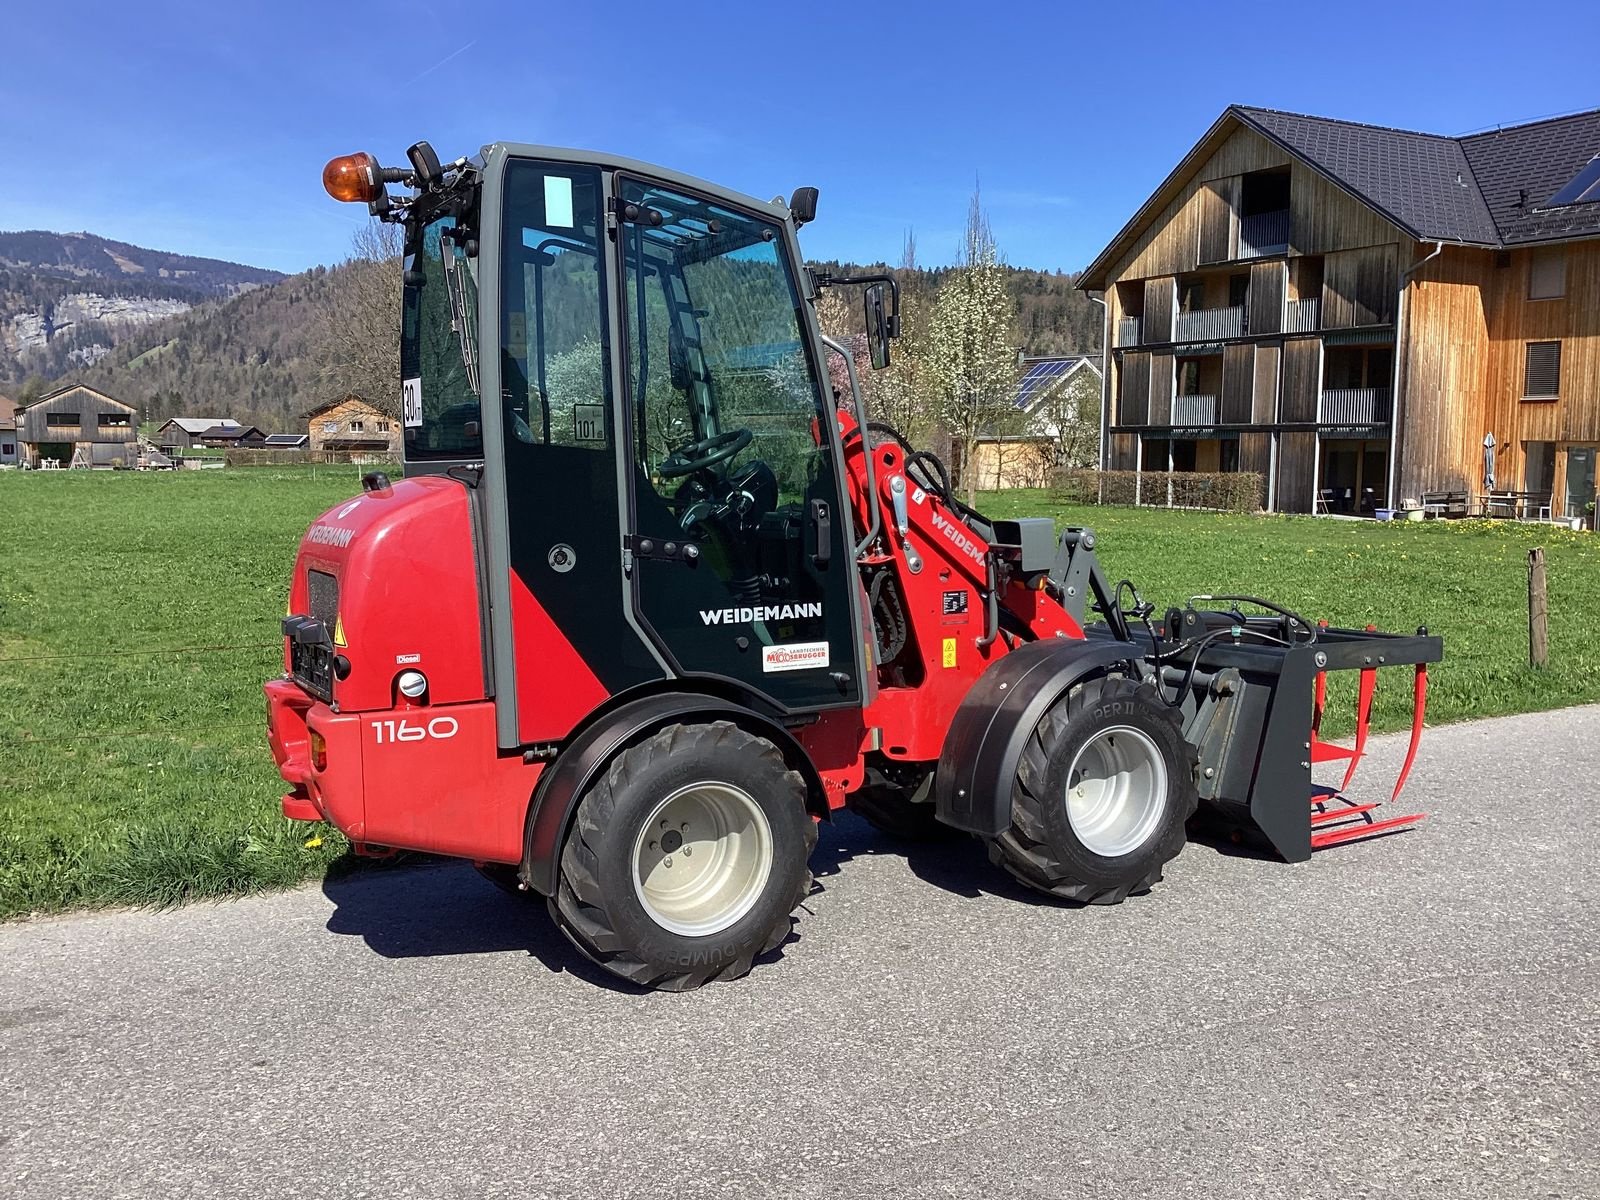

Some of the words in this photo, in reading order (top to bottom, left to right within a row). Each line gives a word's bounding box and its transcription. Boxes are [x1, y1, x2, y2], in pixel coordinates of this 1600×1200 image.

[404, 384, 415, 422] 30
[577, 420, 595, 439] 101
[307, 524, 356, 549] WEIDEMANN
[699, 602, 823, 626] WEIDEMANN
[371, 716, 459, 744] 1160
